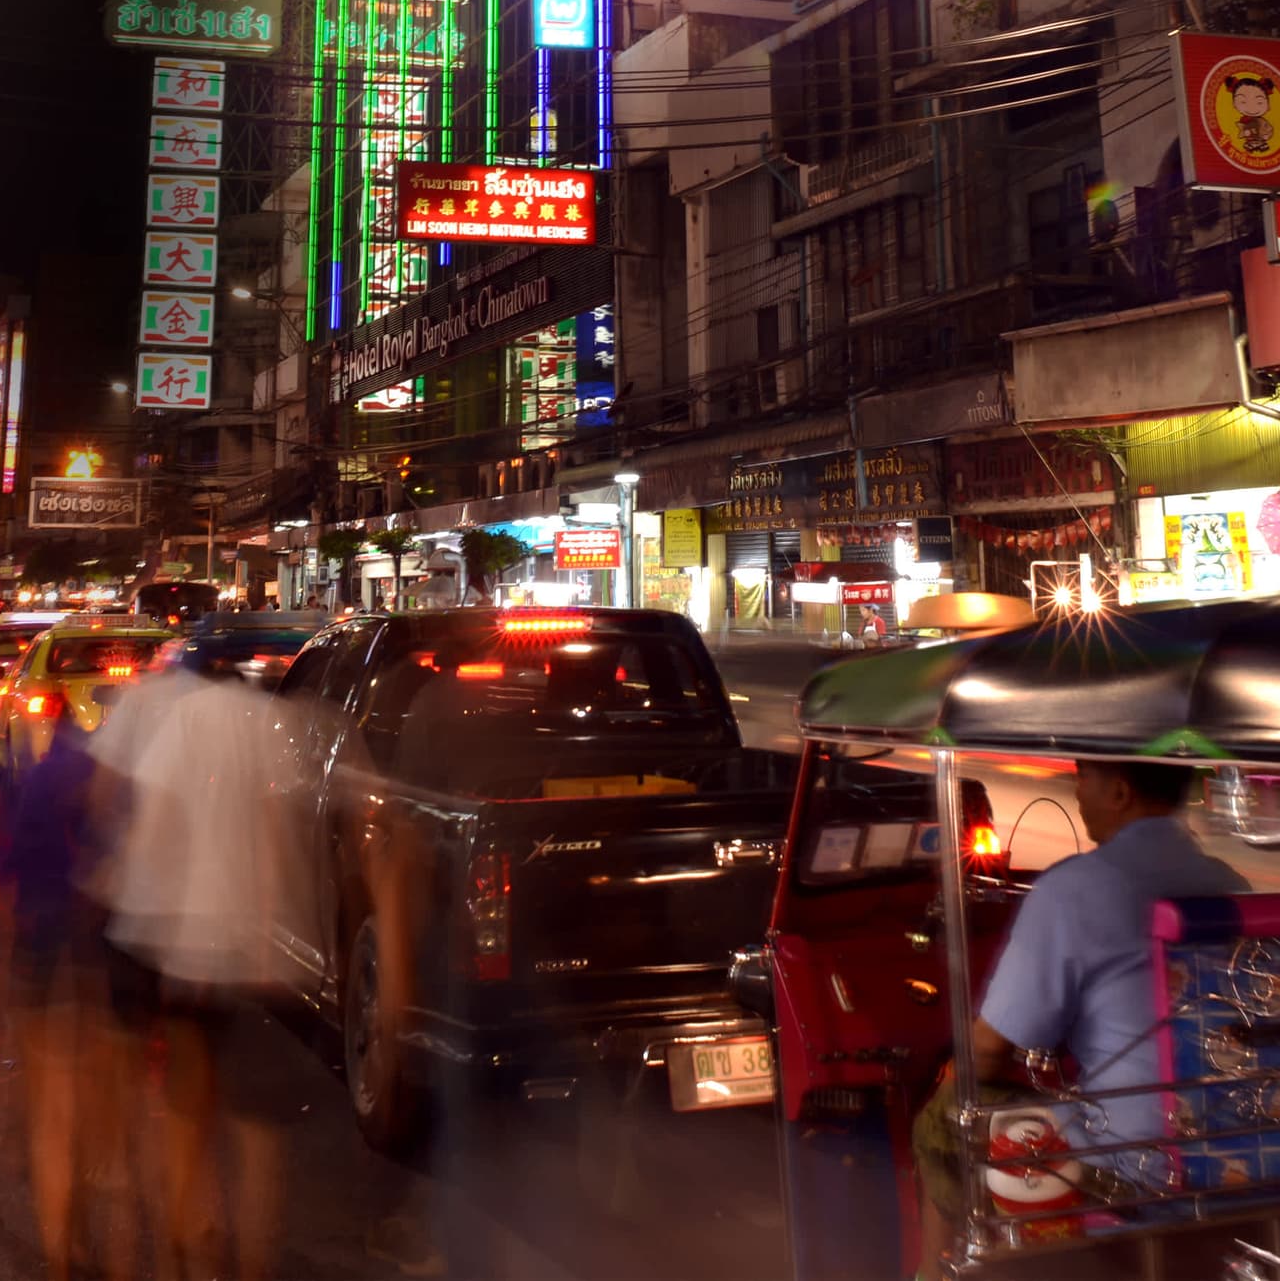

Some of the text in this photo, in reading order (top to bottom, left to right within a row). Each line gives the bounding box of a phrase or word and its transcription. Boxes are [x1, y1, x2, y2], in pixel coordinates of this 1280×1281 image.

[407, 220, 588, 240] LIM SOON HENG NATURAL MEDICINE
[349, 337, 380, 383] Hotel
[382, 319, 418, 371] Royal
